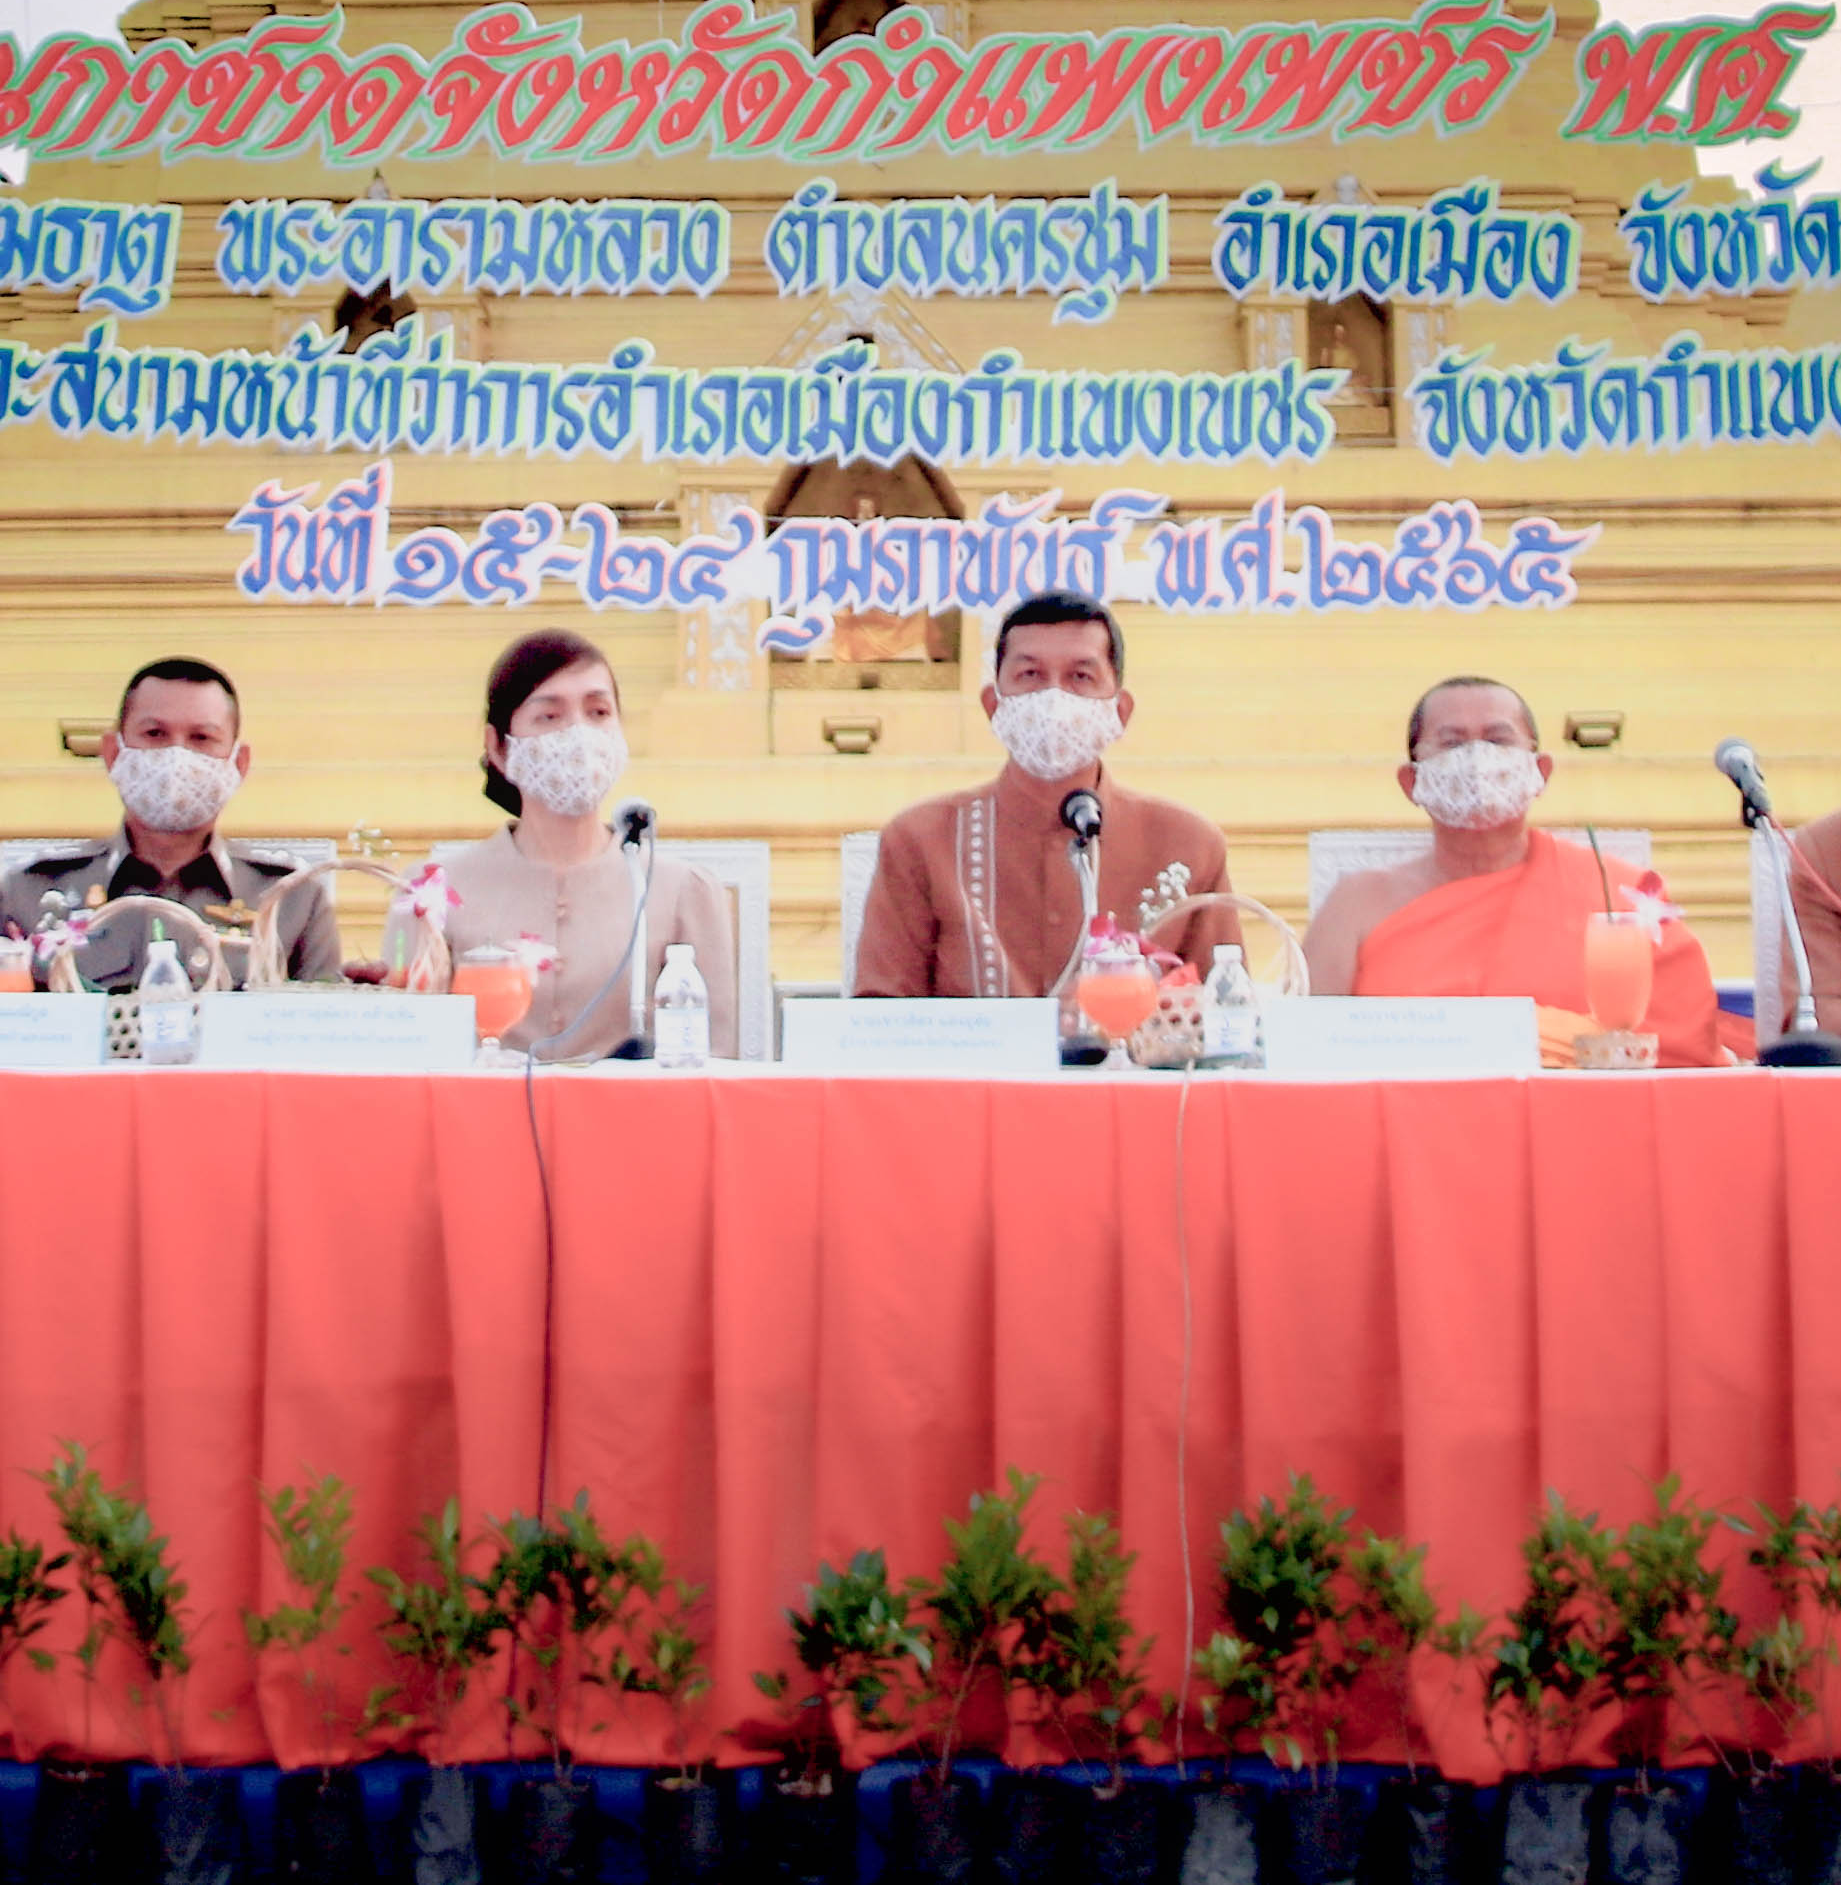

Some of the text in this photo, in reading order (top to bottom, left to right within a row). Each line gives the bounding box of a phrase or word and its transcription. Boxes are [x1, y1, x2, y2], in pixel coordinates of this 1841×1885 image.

[219, 196, 728, 297] พระอารามหลวง
[765, 177, 1168, 325] ตำบลนครชุม
[1215, 179, 1577, 302] อำเภอเมือง
